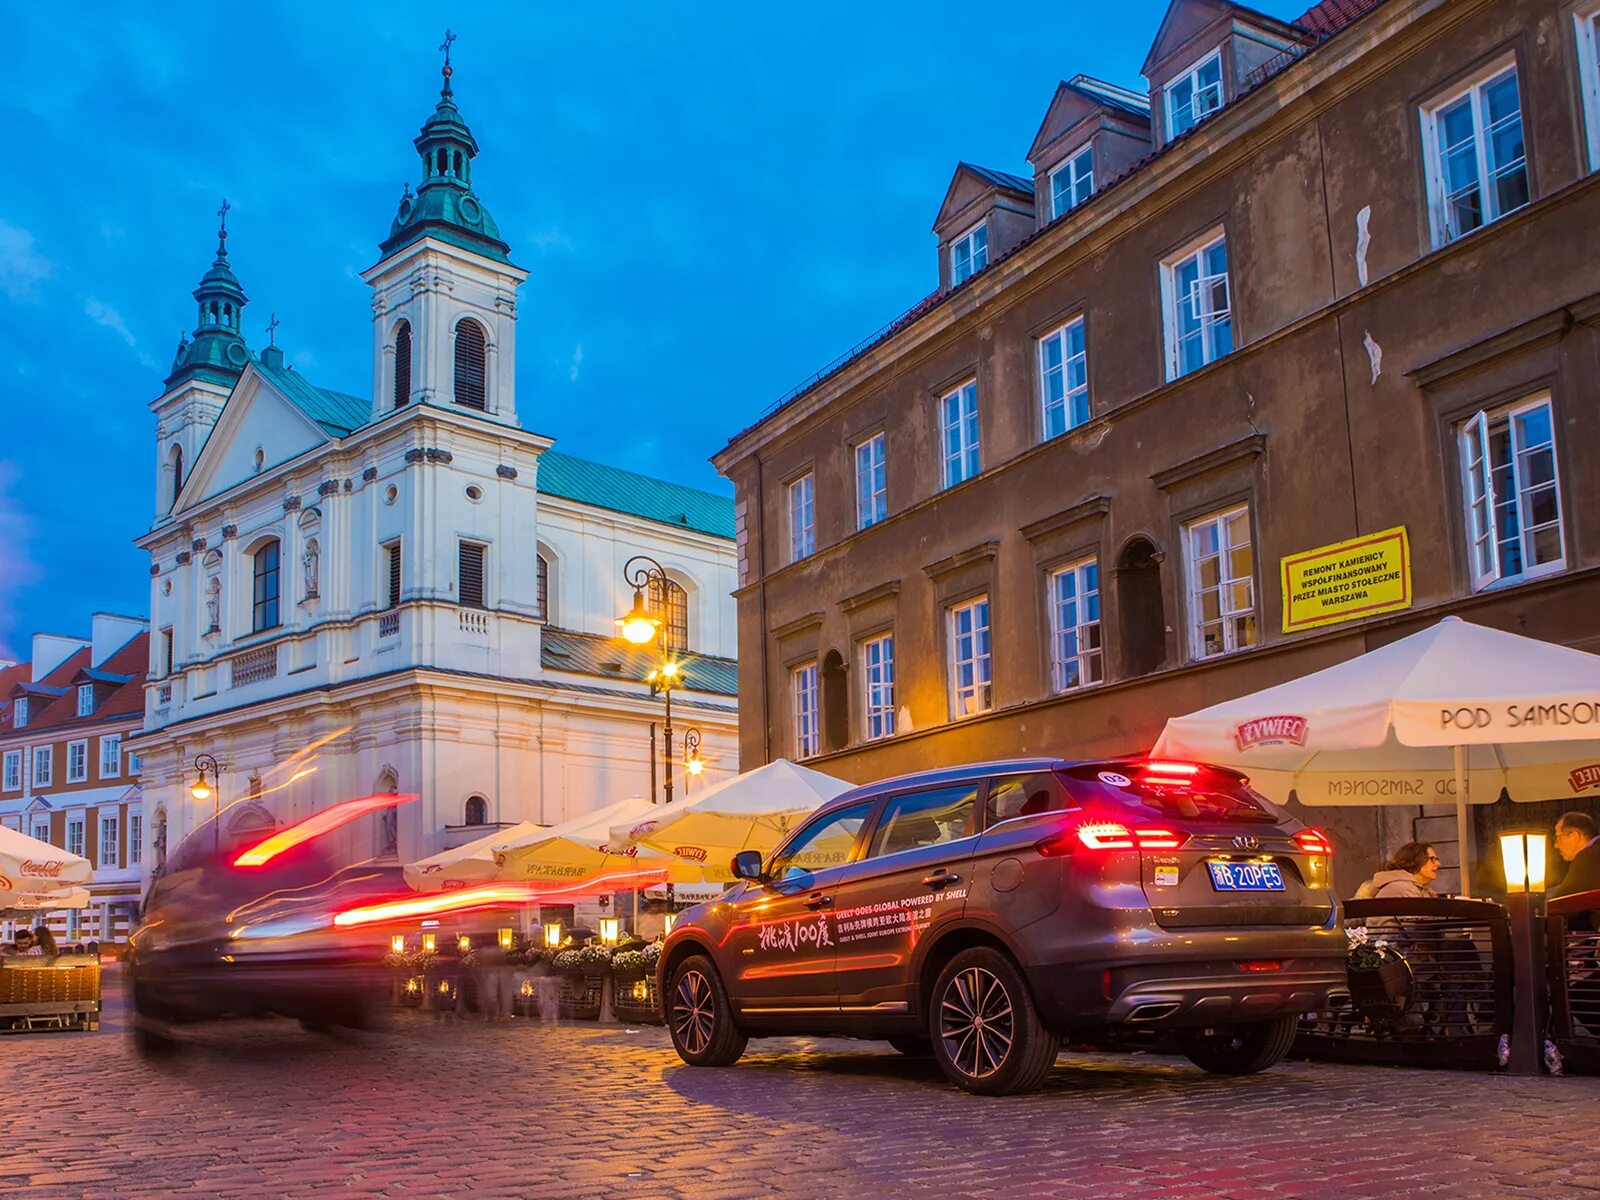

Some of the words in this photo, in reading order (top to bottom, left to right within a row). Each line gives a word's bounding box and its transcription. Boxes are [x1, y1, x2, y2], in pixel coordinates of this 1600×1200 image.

[1301, 562, 1388, 589] WSPÓŁFINANSOWANY
[1303, 563, 1337, 578] REMONT
[1339, 551, 1385, 569] KAMIENICY
[1293, 590, 1316, 603] PRZEZ
[1317, 583, 1350, 597] MIASTO
[1351, 571, 1400, 589] STOŁECZNE
[1321, 590, 1369, 607] WARSZAWA
[1440, 707, 1492, 730] POD
[836, 909, 854, 920] GEELY
[855, 905, 872, 917] GOES
[873, 900, 899, 912] GLOBAL
[901, 894, 934, 908] POWERED
[935, 892, 945, 902] BY
[946, 889, 966, 900] SHELL
